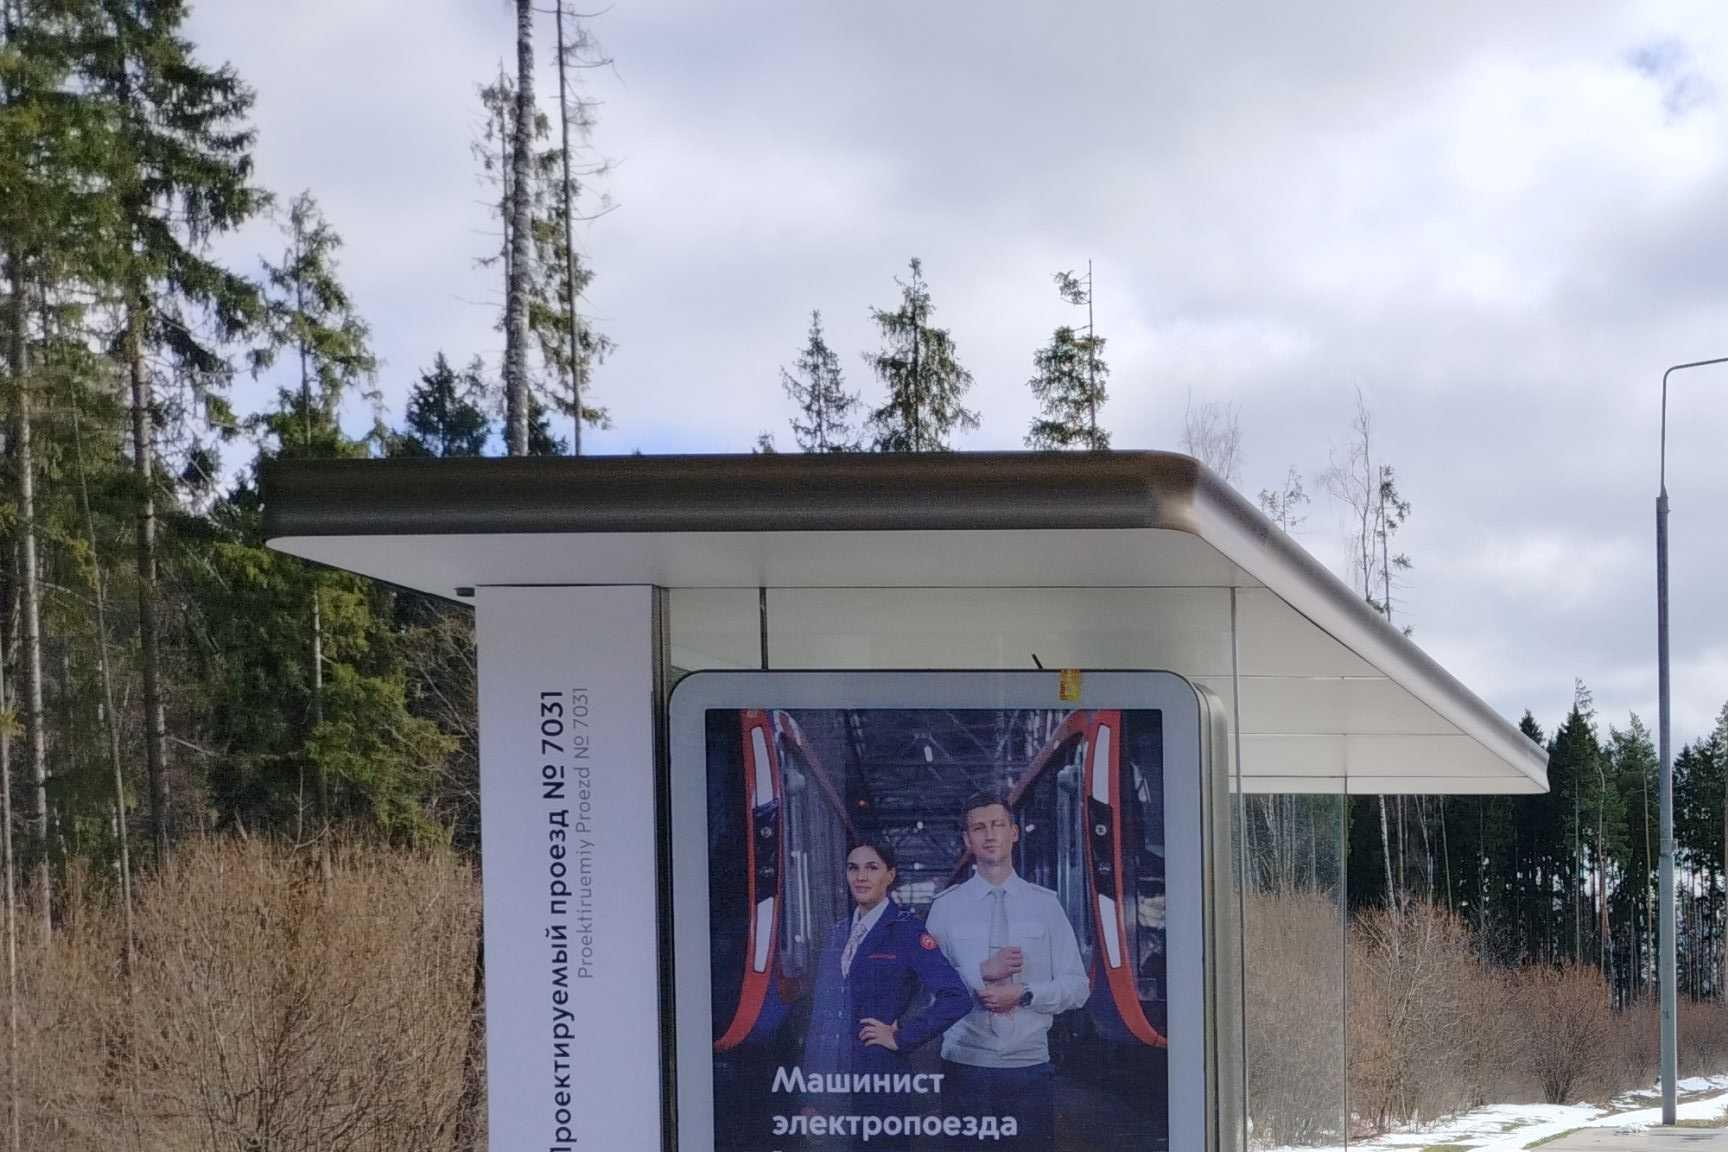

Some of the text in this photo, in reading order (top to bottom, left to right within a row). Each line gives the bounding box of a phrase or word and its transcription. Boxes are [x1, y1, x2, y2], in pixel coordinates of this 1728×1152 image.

[540, 692, 564, 755] 7031
[542, 764, 565, 799] №
[572, 688, 595, 979] Proektiruemiy Proezd № 7031
[549, 809, 573, 914] проезд
[771, 1066, 944, 1093] Машинист
[771, 1114, 1018, 1141] электропоезда
